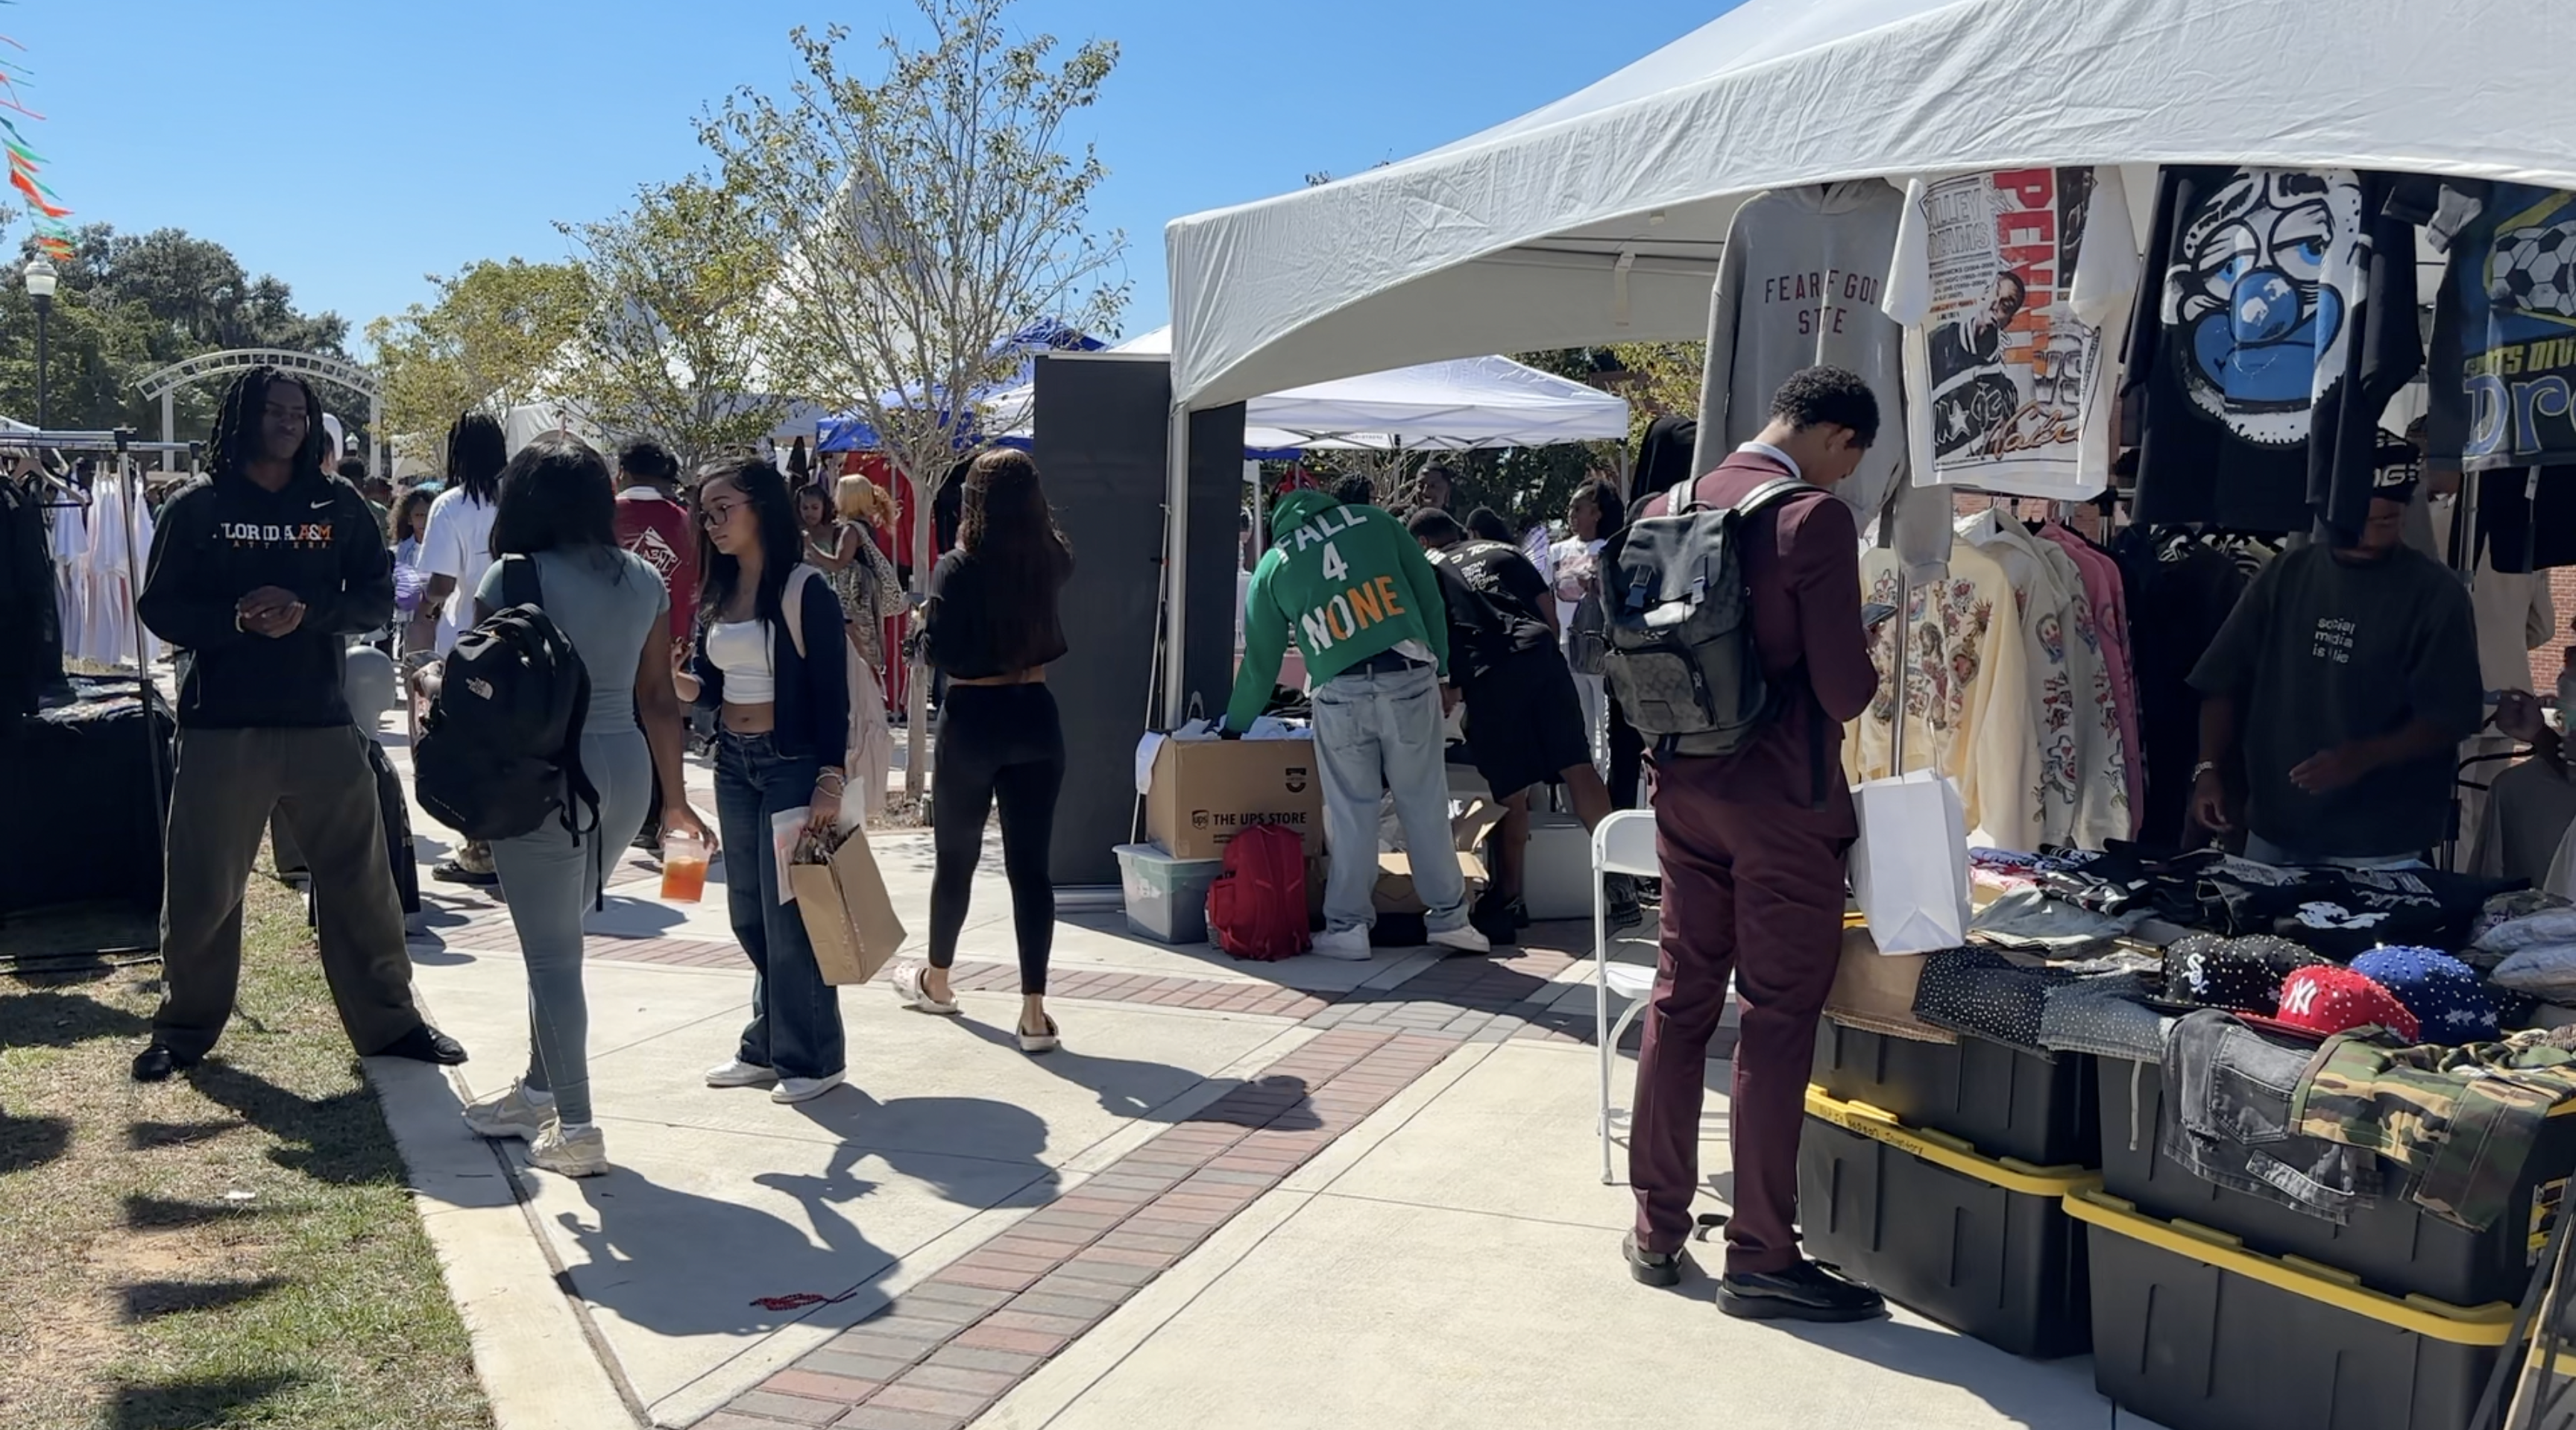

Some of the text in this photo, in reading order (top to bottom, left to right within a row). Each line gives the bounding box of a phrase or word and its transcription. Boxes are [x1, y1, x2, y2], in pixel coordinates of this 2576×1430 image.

[1765, 272, 1820, 303] FEAR
[1798, 306, 1847, 335] STTE
[2527, 337, 2576, 372] DIV
[2462, 373, 2576, 460] Dr
[212, 523, 333, 541] LORIDA A&M
[1273, 505, 1368, 564] FALL
[1323, 541, 1348, 581] 4
[1301, 576, 1405, 656] NONE
[1213, 812, 1306, 825] THE UPS STORE
[2284, 977, 2317, 1015] NY
